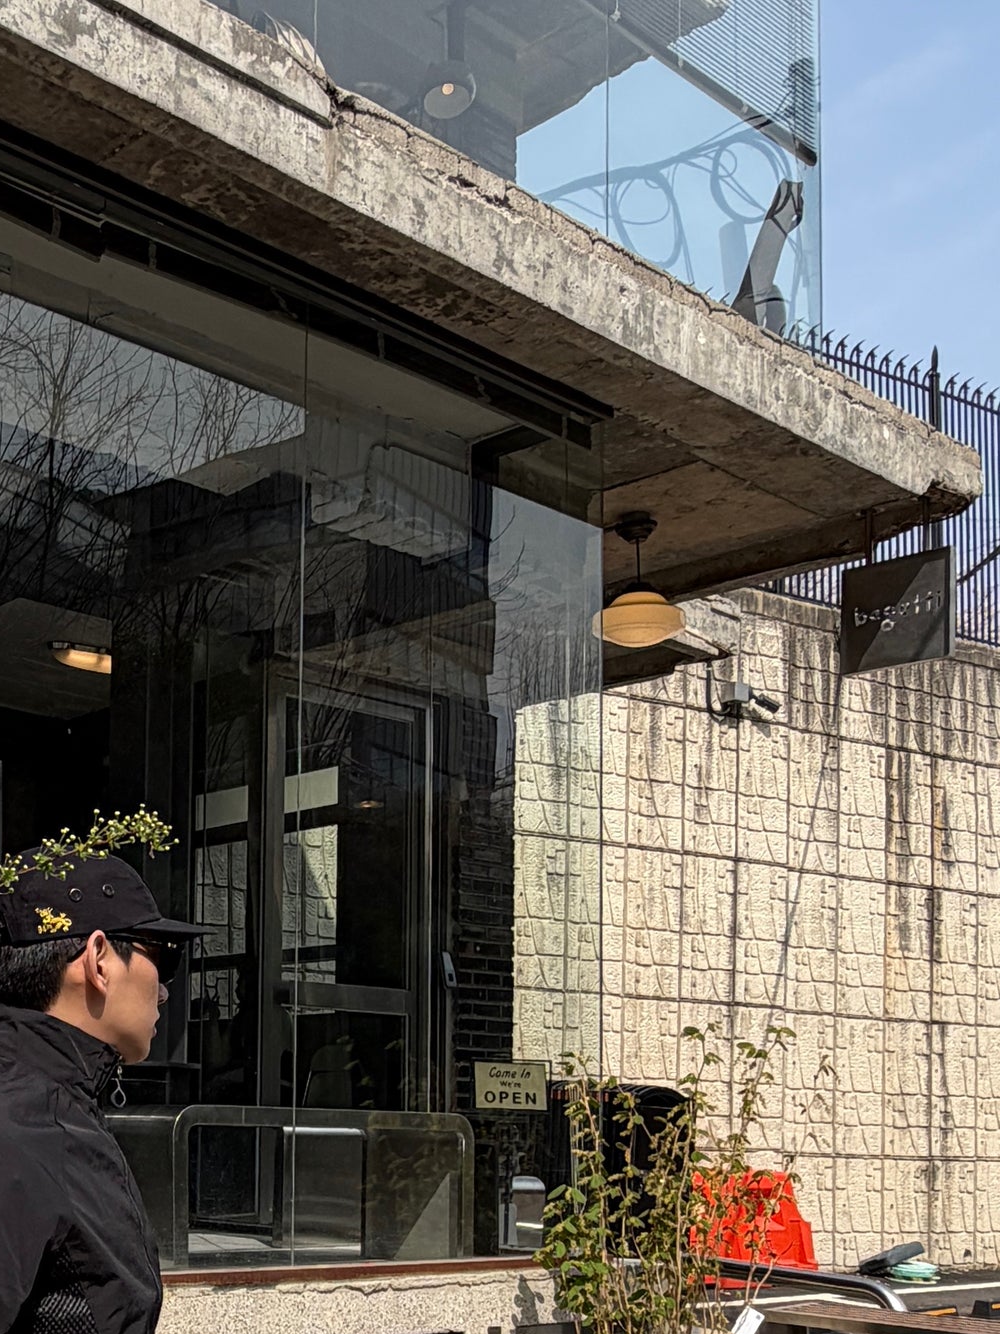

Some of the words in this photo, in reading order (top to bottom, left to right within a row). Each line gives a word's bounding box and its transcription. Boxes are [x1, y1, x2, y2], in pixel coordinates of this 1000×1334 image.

[489, 1066, 517, 1079] Come
[520, 1068, 531, 1079] In
[484, 1090, 537, 1105] OPEN
